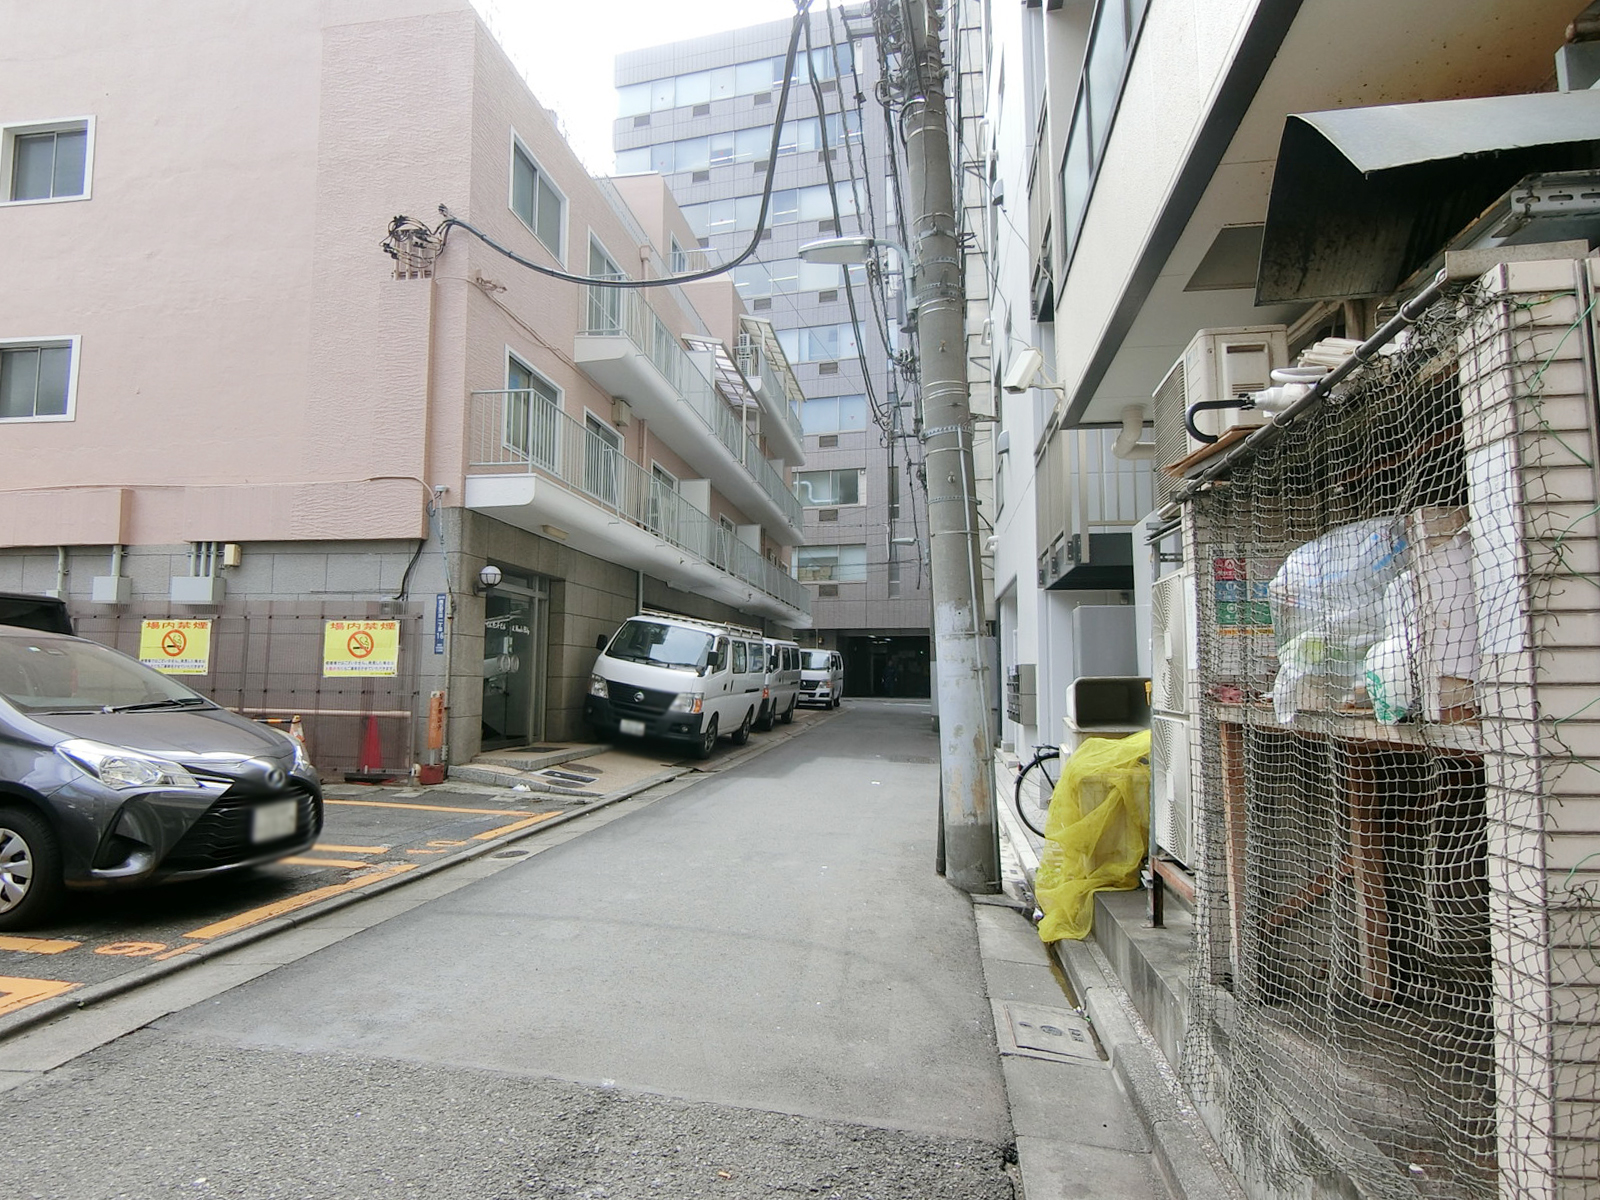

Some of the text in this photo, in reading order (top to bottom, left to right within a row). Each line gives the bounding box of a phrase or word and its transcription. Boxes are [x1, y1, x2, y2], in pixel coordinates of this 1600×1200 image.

[146, 621, 208, 629] 場内禁煙
[330, 622, 396, 631] 場内禁煙
